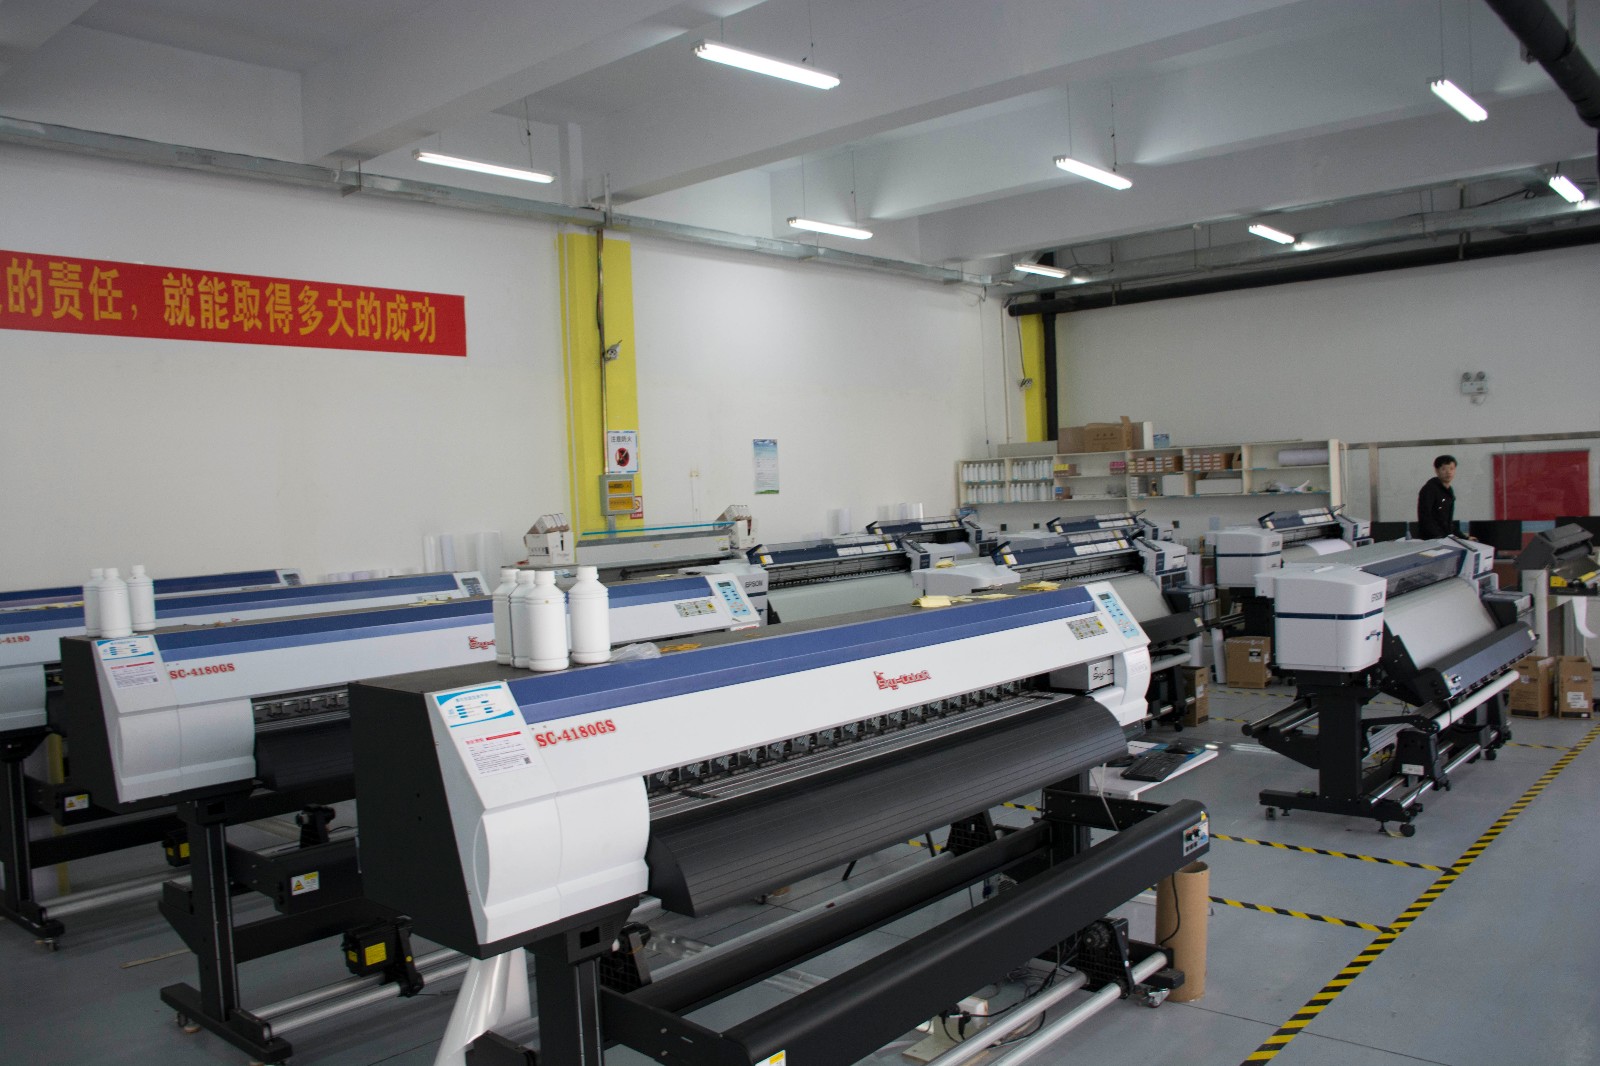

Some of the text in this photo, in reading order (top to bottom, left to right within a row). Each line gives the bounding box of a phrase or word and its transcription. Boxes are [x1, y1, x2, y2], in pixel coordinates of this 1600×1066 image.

[0, 257, 436, 343] 的责任，就能取得多大的成功
[745, 580, 763, 588] EPSON
[0, 635, 30, 644] -4180
[169, 663, 235, 680] SC-4180GS
[535, 719, 617, 748] SC-4180GS
